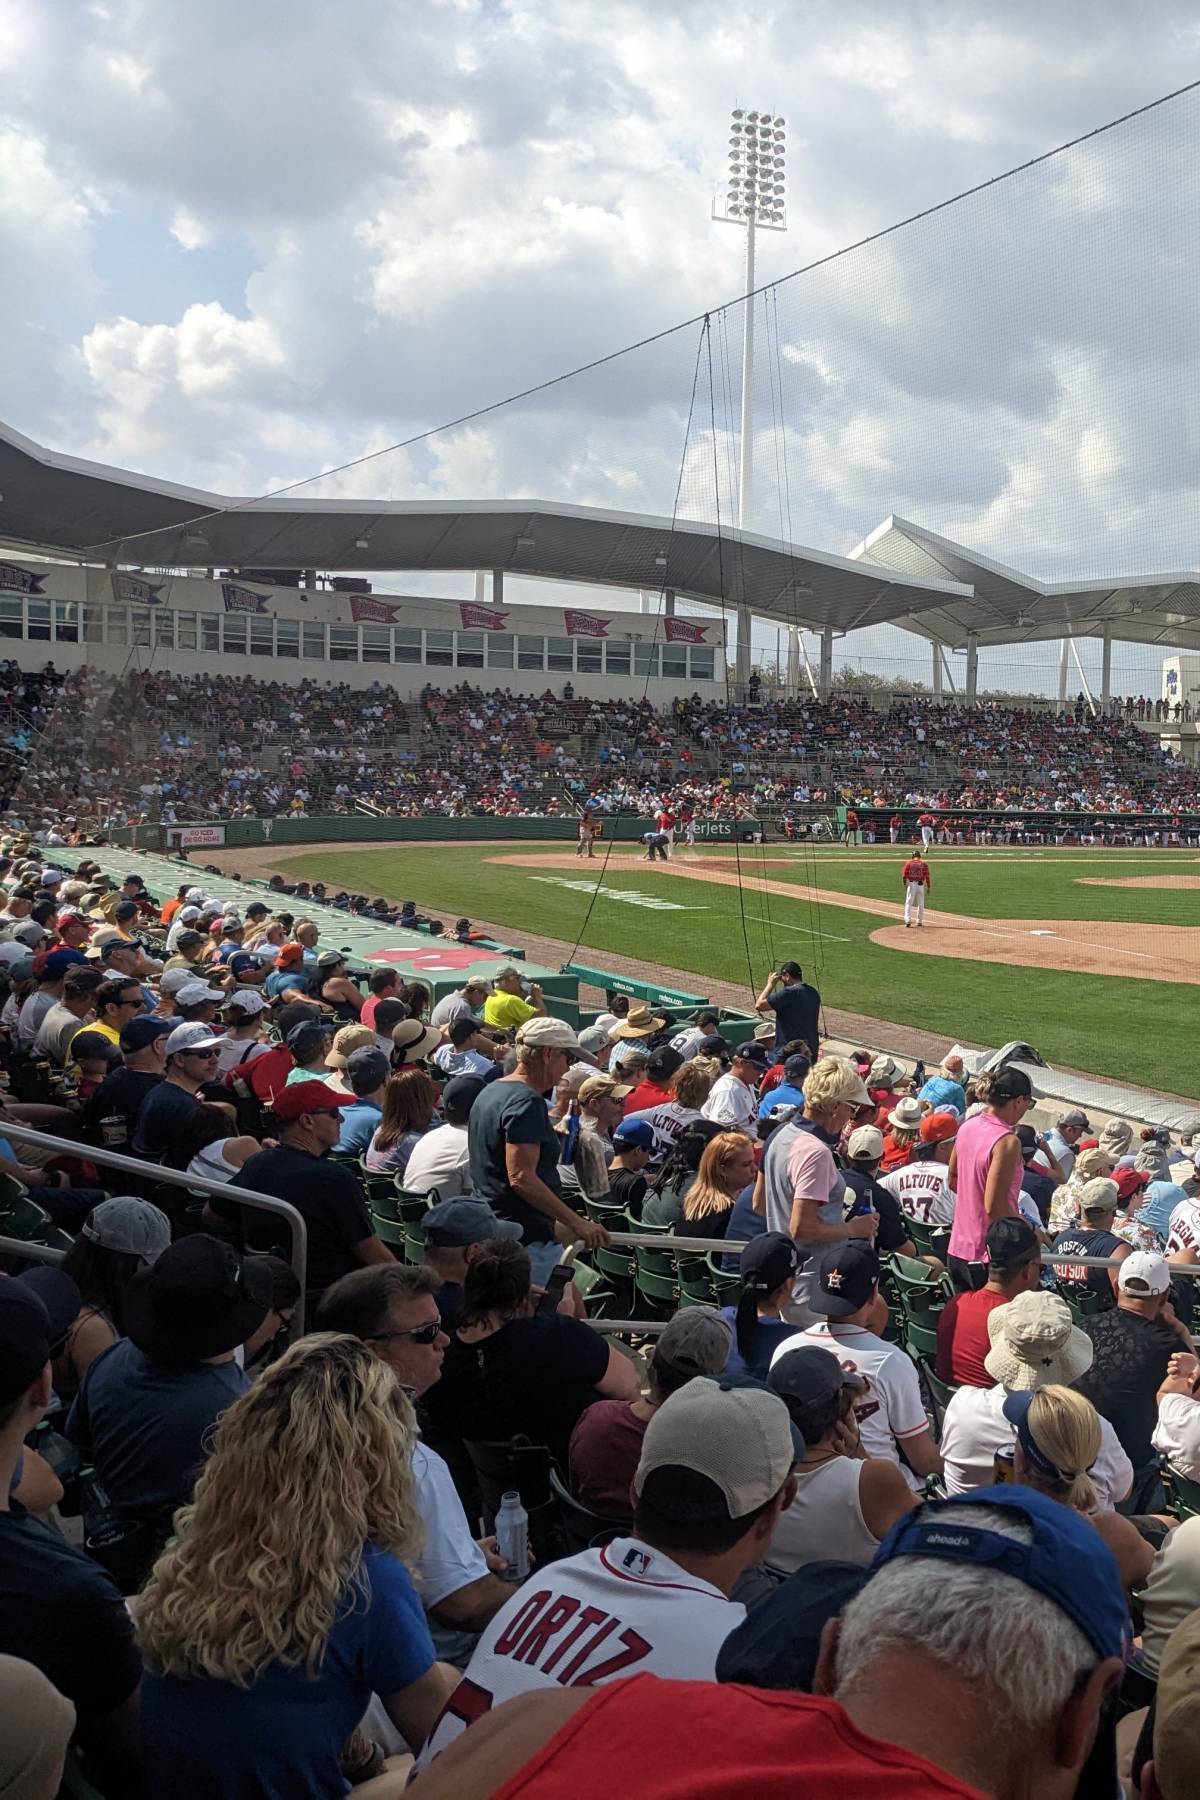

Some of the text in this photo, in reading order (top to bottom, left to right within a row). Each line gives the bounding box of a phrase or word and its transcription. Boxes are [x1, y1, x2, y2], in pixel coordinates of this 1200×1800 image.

[674, 820, 731, 836] UerJets
[900, 1174, 943, 1193] ALTUVE
[927, 1533, 961, 1547] ahead
[494, 1590, 653, 1687] ORTIZ
